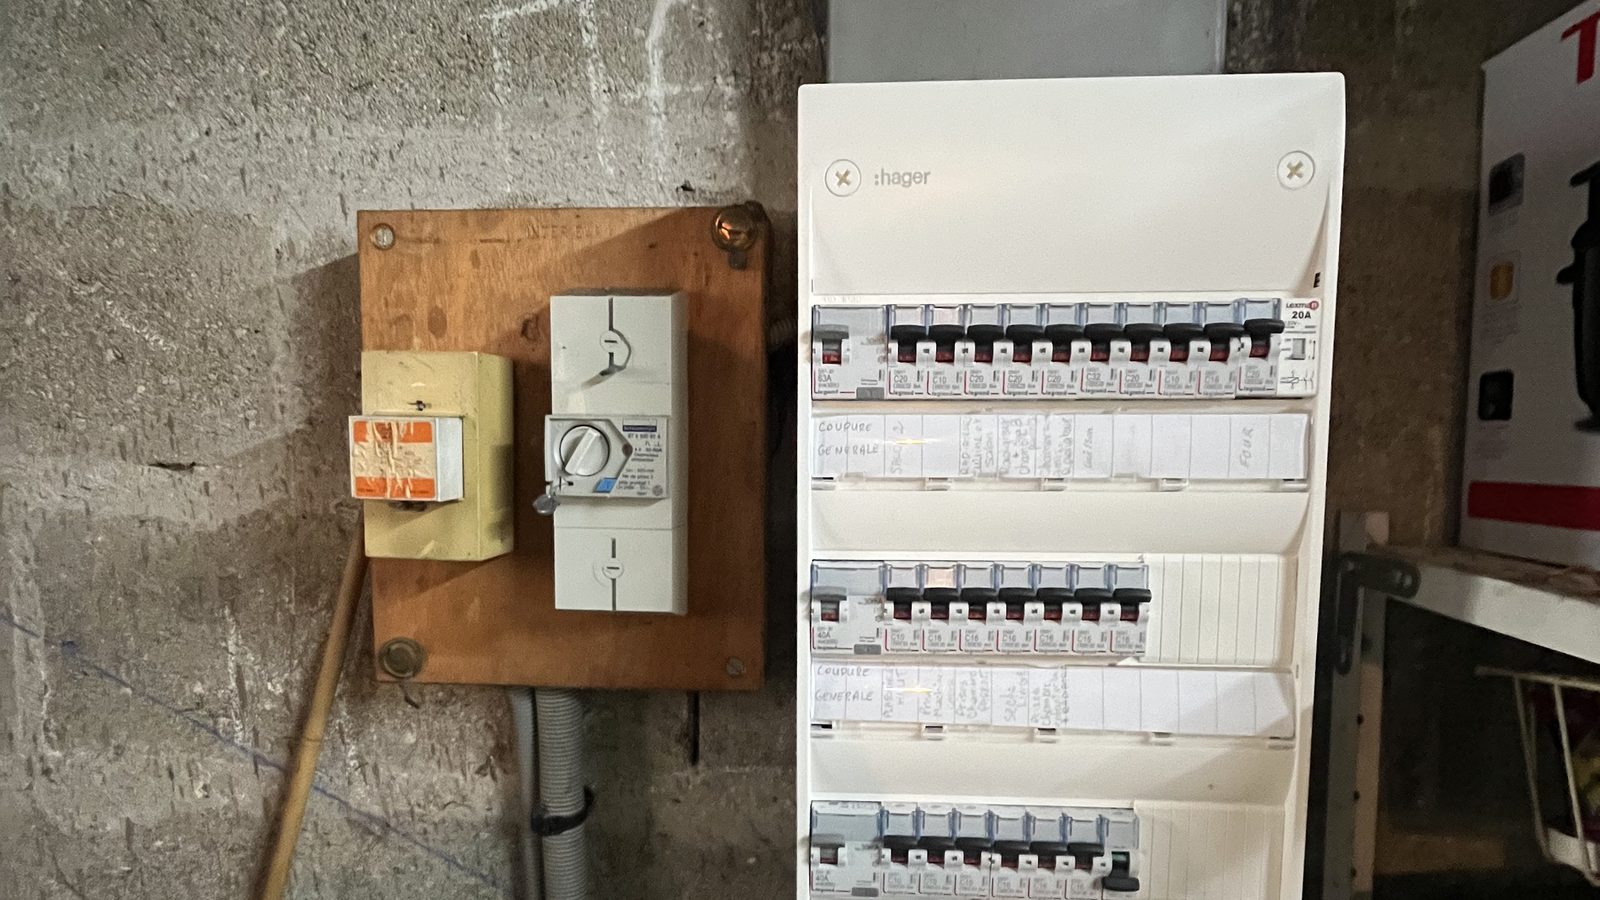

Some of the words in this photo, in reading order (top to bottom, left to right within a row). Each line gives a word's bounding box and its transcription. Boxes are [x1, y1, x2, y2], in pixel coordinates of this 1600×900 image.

[1291, 310, 1311, 320] 20A
[817, 374, 832, 383] 63A
[818, 421, 873, 433] COUPURE
[817, 443, 880, 456] GENERALE
[1238, 427, 1254, 469] FOUR
